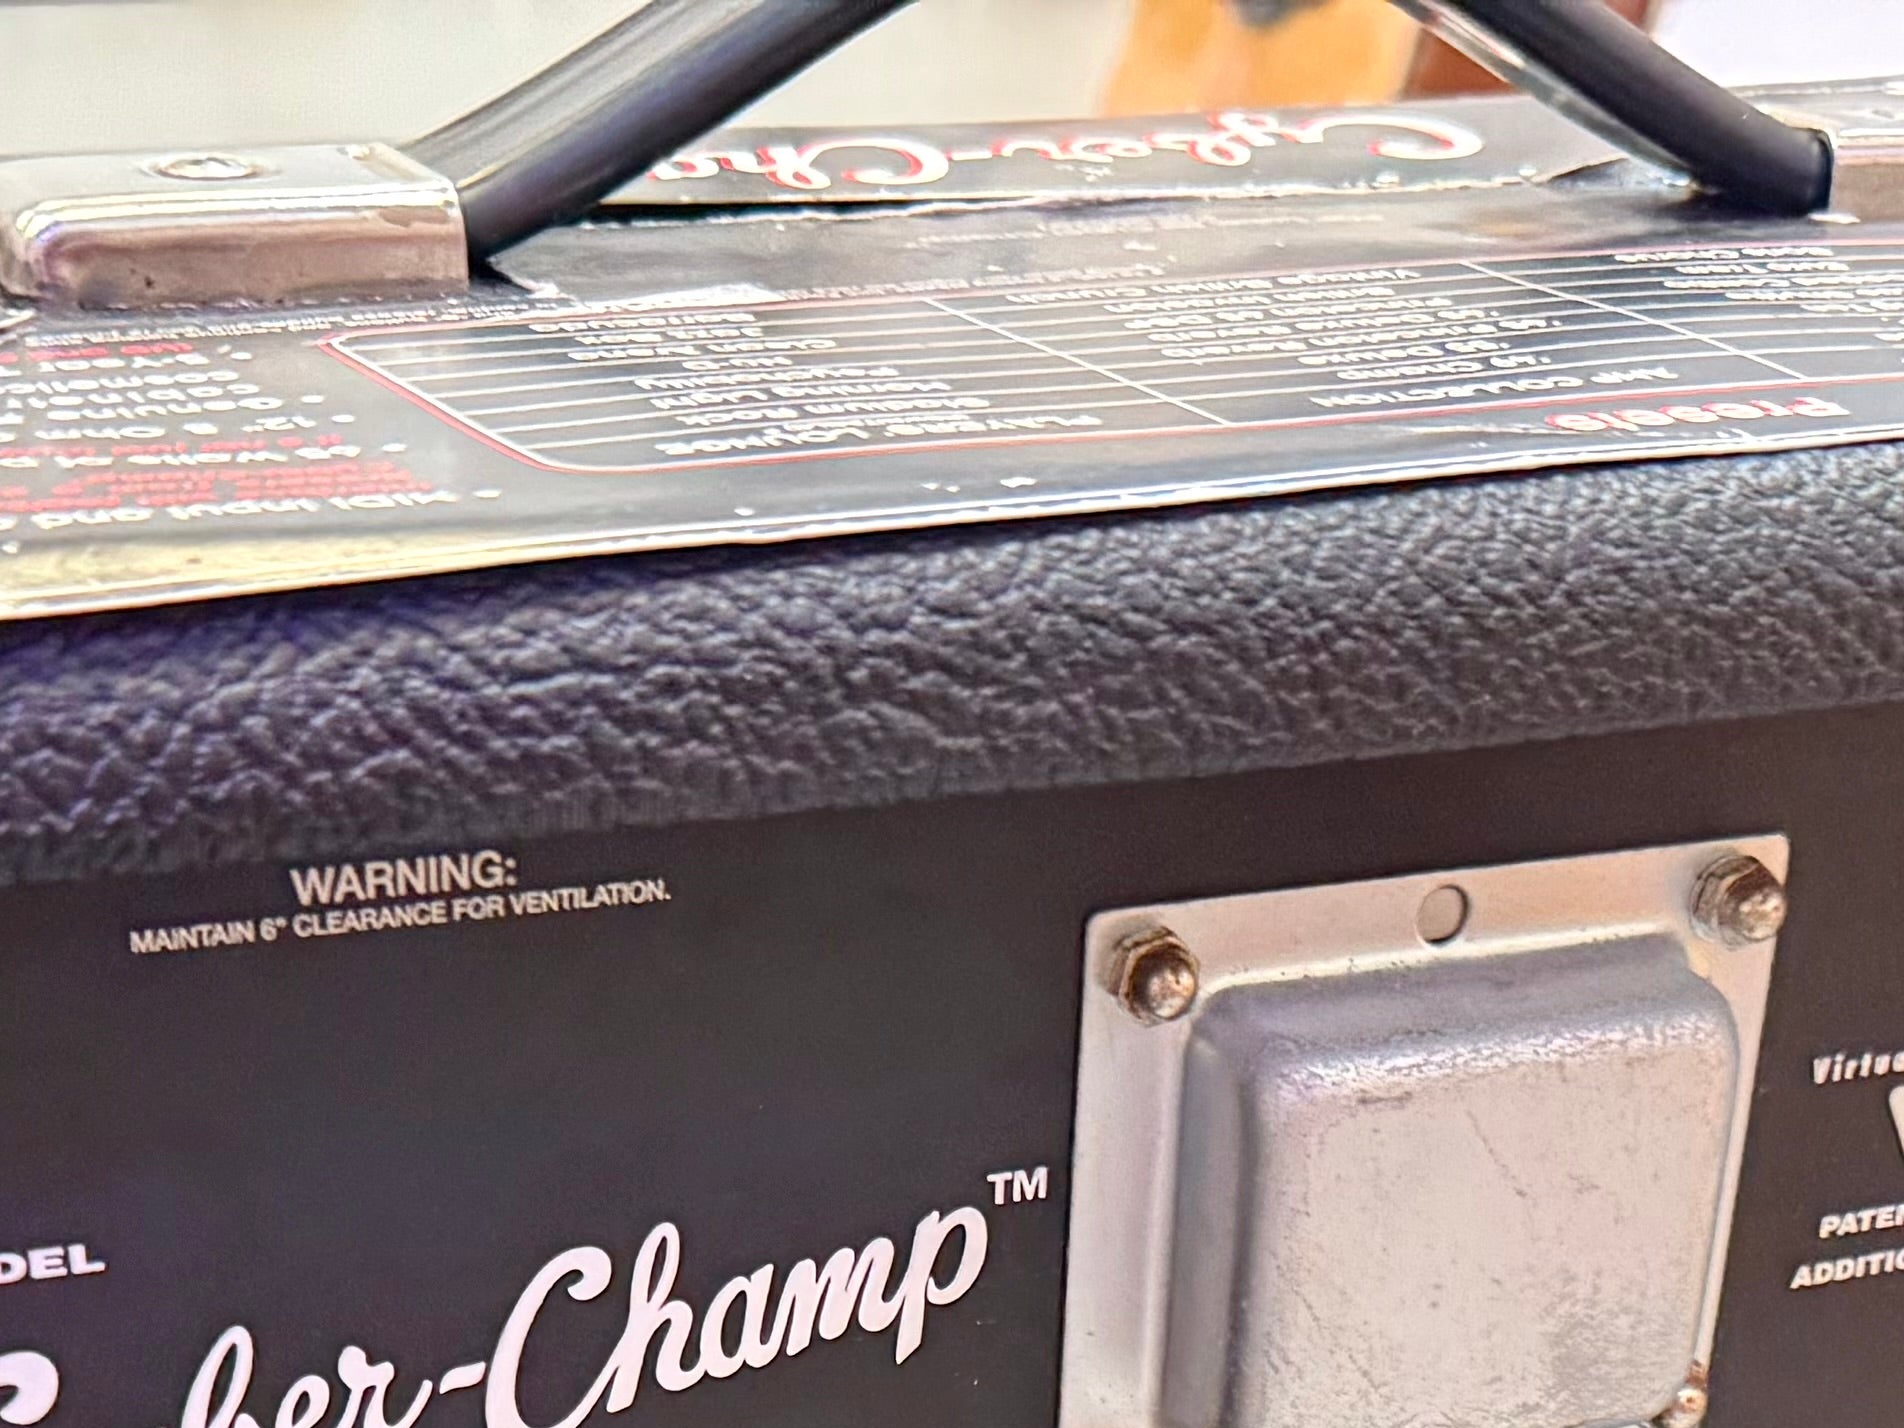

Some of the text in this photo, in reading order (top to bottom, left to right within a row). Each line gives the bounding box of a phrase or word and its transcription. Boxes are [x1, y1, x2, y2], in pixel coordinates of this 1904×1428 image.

[645, 112, 1483, 190] Cyber-Cha
[1297, 346, 1443, 365] Deluxe
[1337, 362, 1484, 380] Champ
[650, 381, 952, 409] Morning Light
[1309, 377, 1584, 407] COLLECTION
[47, 397, 284, 421] Genuine
[675, 408, 799, 426] Rock
[1546, 397, 1850, 432] Presets
[34, 427, 165, 439] Ohm
[167, 498, 320, 521] input
[328, 490, 459, 509] MIDI
[31, 507, 153, 529] and
[288, 848, 517, 907] WARNING:
[128, 877, 672, 954] MAINTAIN 6" CLEARANCE FOR VENTILATION.
[985, 1164, 1049, 1206] TM
